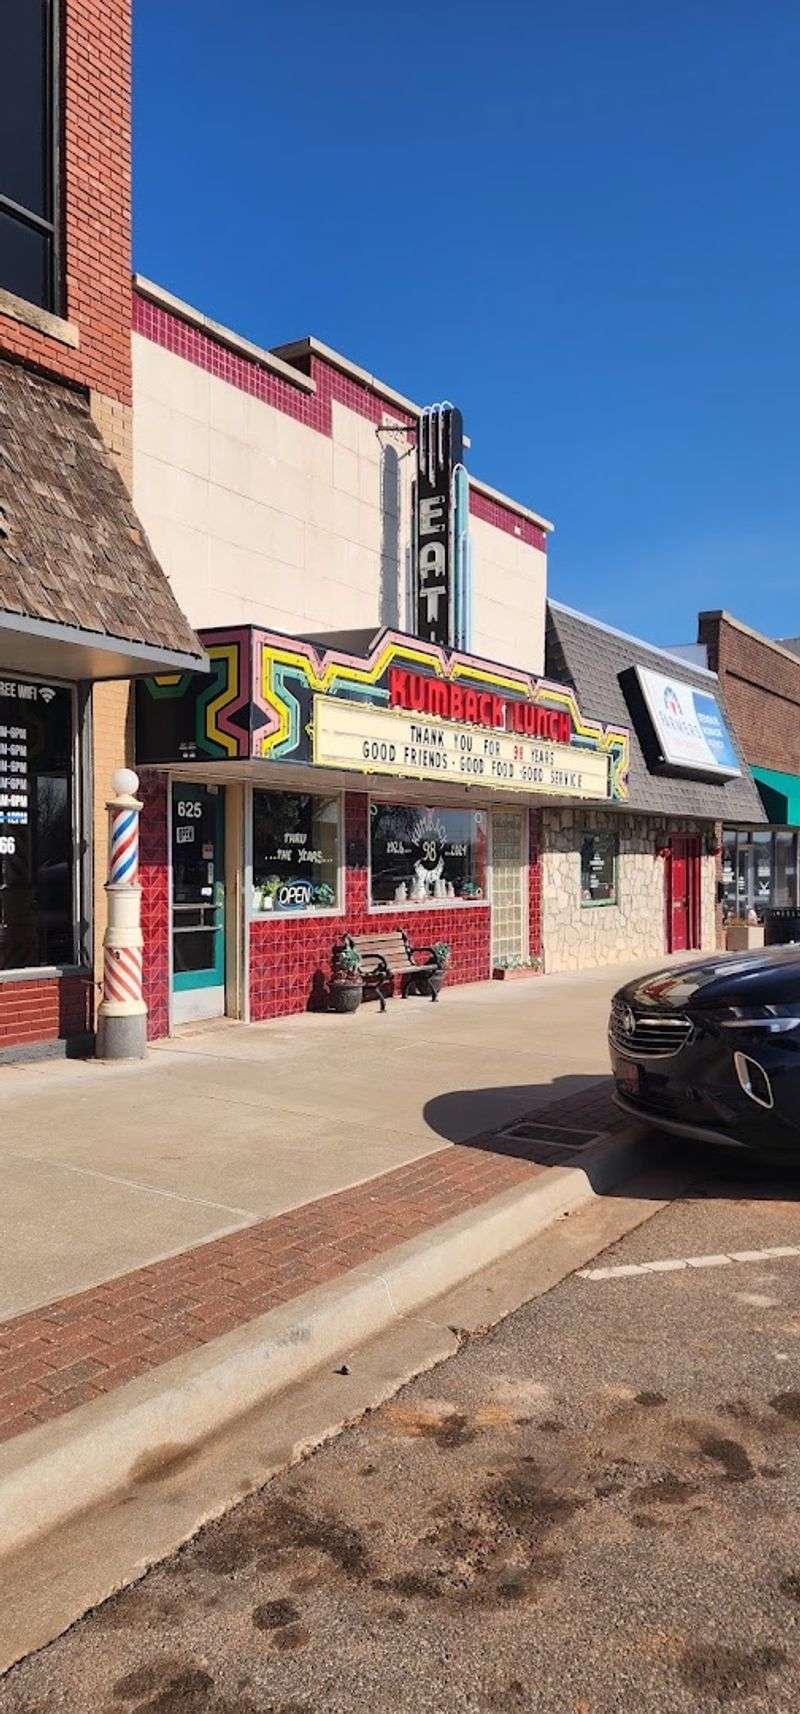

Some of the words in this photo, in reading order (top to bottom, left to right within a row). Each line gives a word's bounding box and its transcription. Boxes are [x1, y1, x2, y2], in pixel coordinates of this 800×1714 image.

[419, 496, 446, 623] EAT
[18, 684, 37, 701] WIFI
[389, 667, 505, 728] KUMBACK
[513, 702, 571, 743] LUNCH
[410, 725, 444, 747] THANK
[454, 734, 473, 752] YOU
[484, 740, 500, 756] FOR
[531, 748, 554, 766] YEARS
[363, 741, 396, 761] GOOD
[404, 747, 448, 769] FRIENDS
[460, 756, 484, 773] GOOD
[492, 760, 513, 778] FOOD
[551, 770, 582, 788] SERVICE
[177, 802, 202, 817] 625
[422, 841, 436, 861] 98
[280, 886, 311, 903] OPEN
